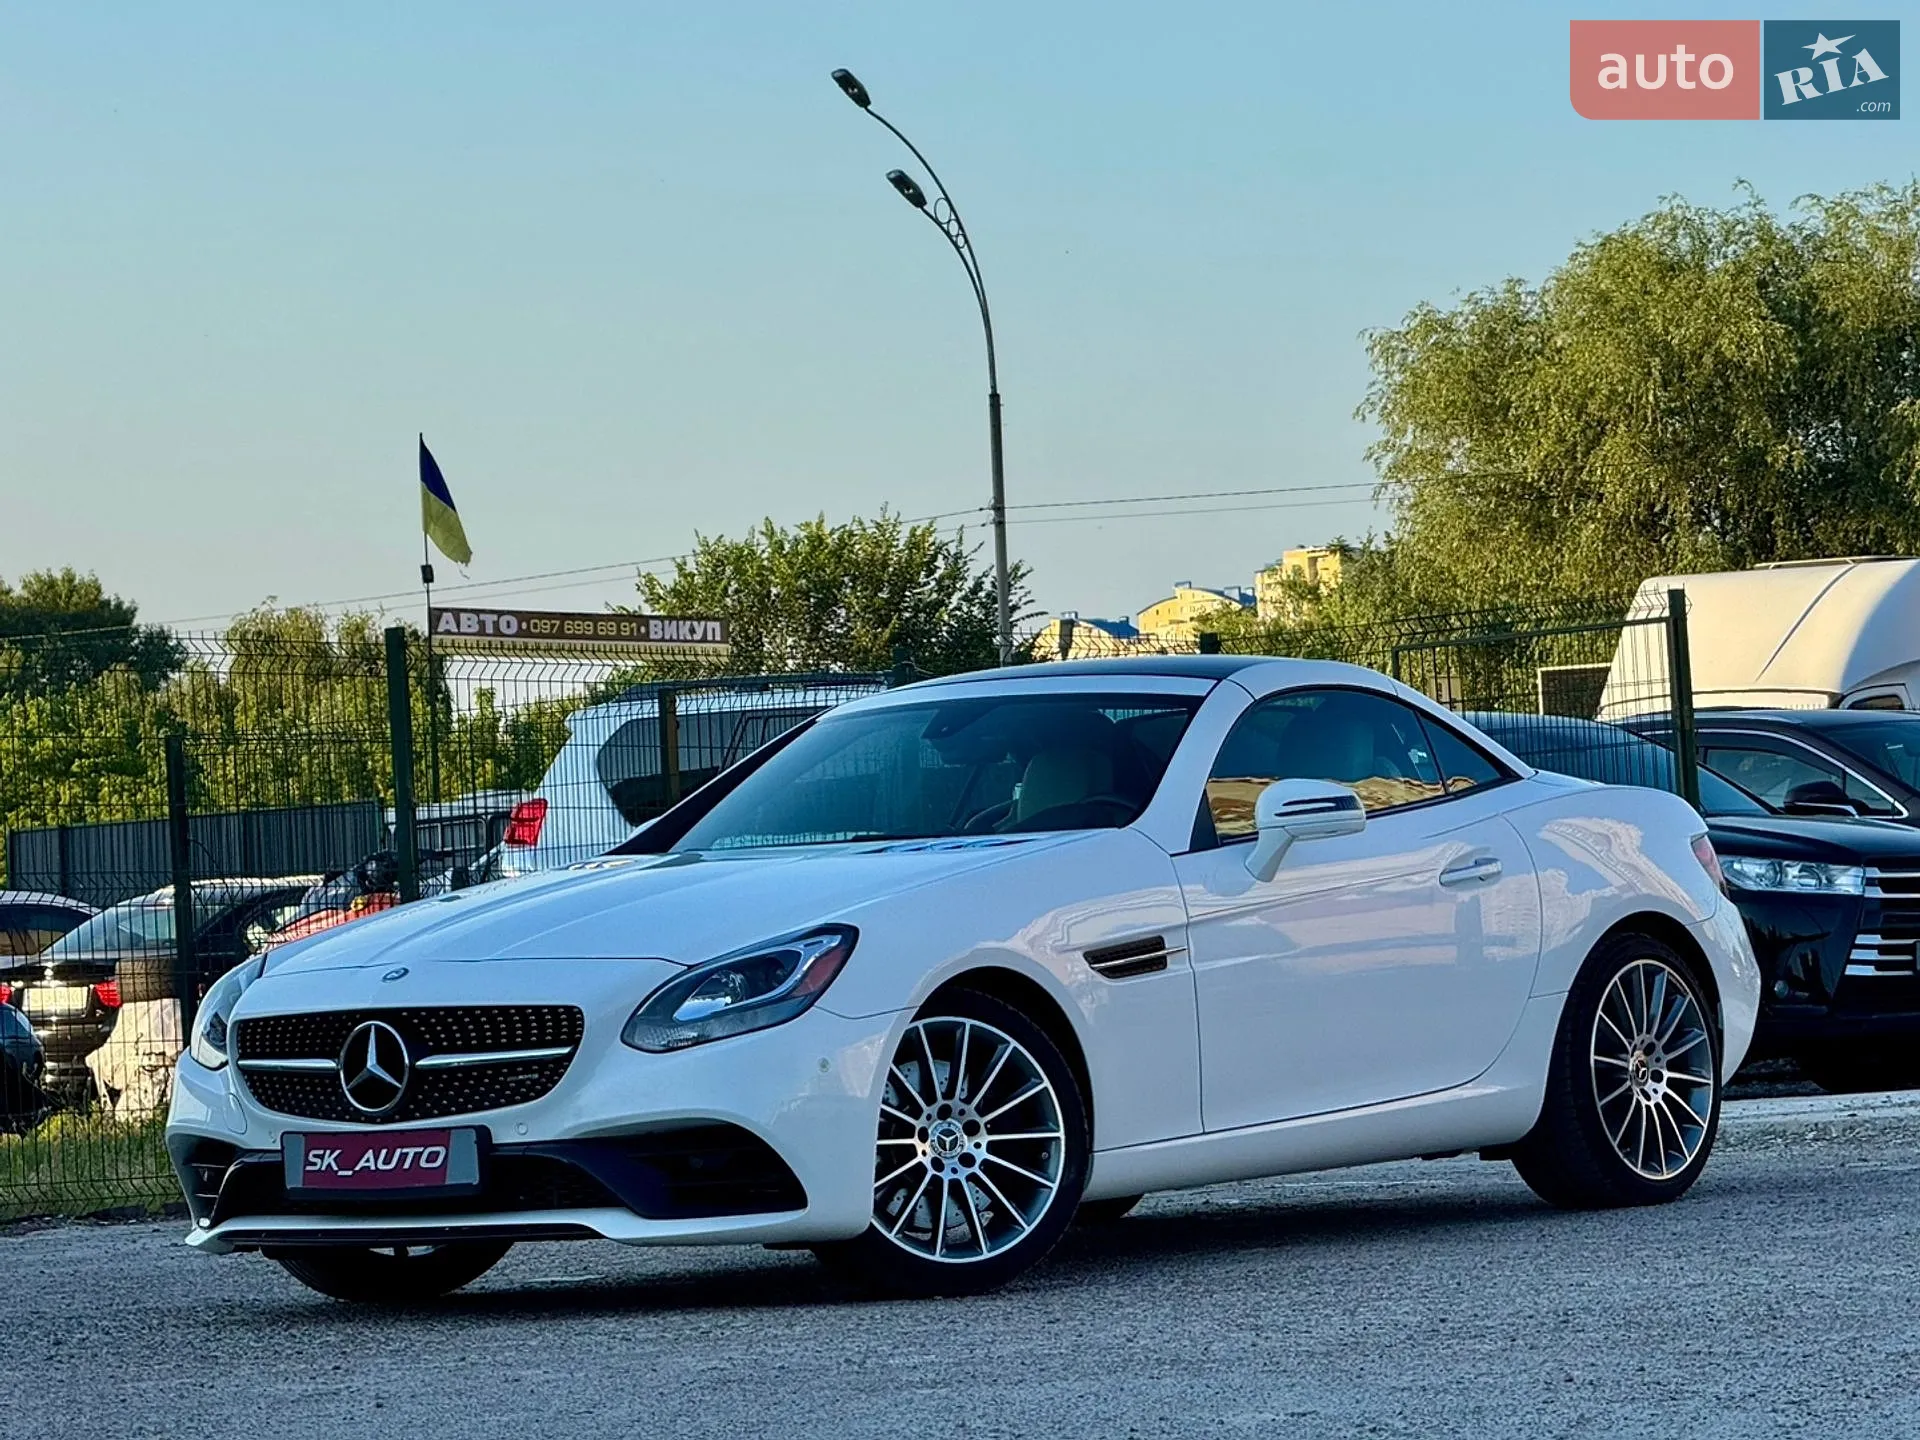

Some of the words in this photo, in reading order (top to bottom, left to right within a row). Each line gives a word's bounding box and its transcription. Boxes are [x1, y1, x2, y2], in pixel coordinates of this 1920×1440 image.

[436, 612, 519, 635] АВТО
[529, 618, 561, 634] 097
[563, 619, 594, 635] 699
[597, 621, 617, 636] 69
[619, 622, 638, 637] 91
[648, 619, 722, 641] ВИКУП
[305, 1145, 448, 1176] SK_AUTO
